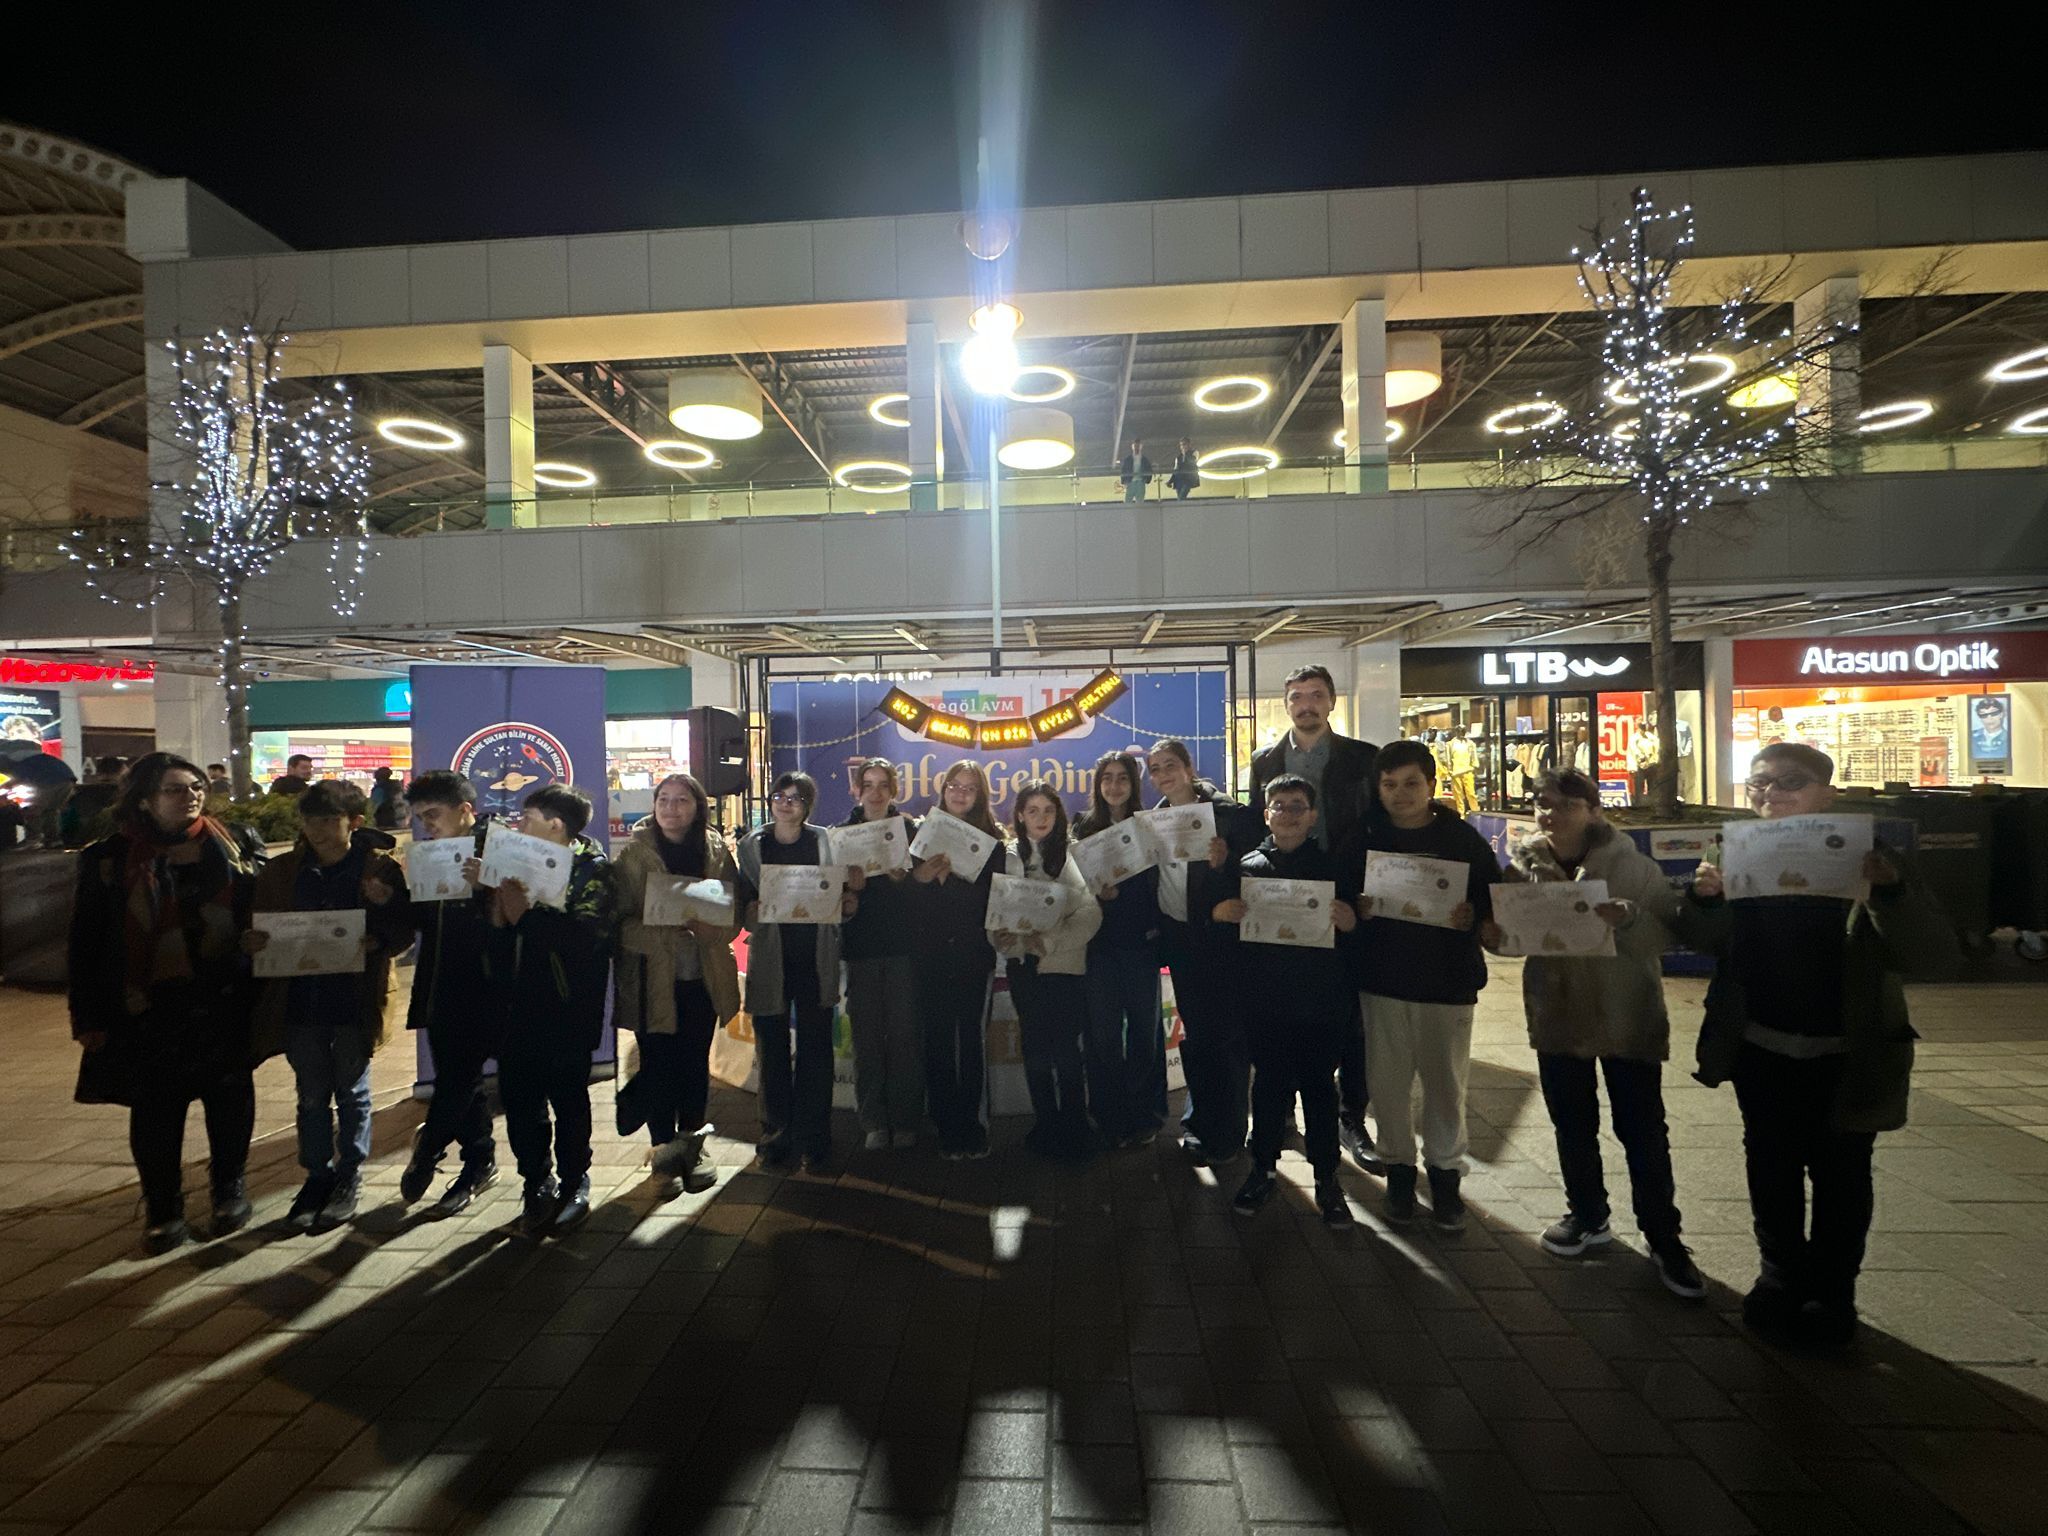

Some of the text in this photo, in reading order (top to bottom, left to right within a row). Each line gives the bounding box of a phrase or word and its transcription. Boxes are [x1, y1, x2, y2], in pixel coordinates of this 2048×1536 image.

[1482, 651, 1569, 685] LTB
[1800, 641, 2000, 676] Atasun Optik
[982, 701, 1015, 712] AVM
[484, 731, 508, 745] SULTAN
[526, 733, 537, 742] VE
[535, 738, 554, 755] SANAT
